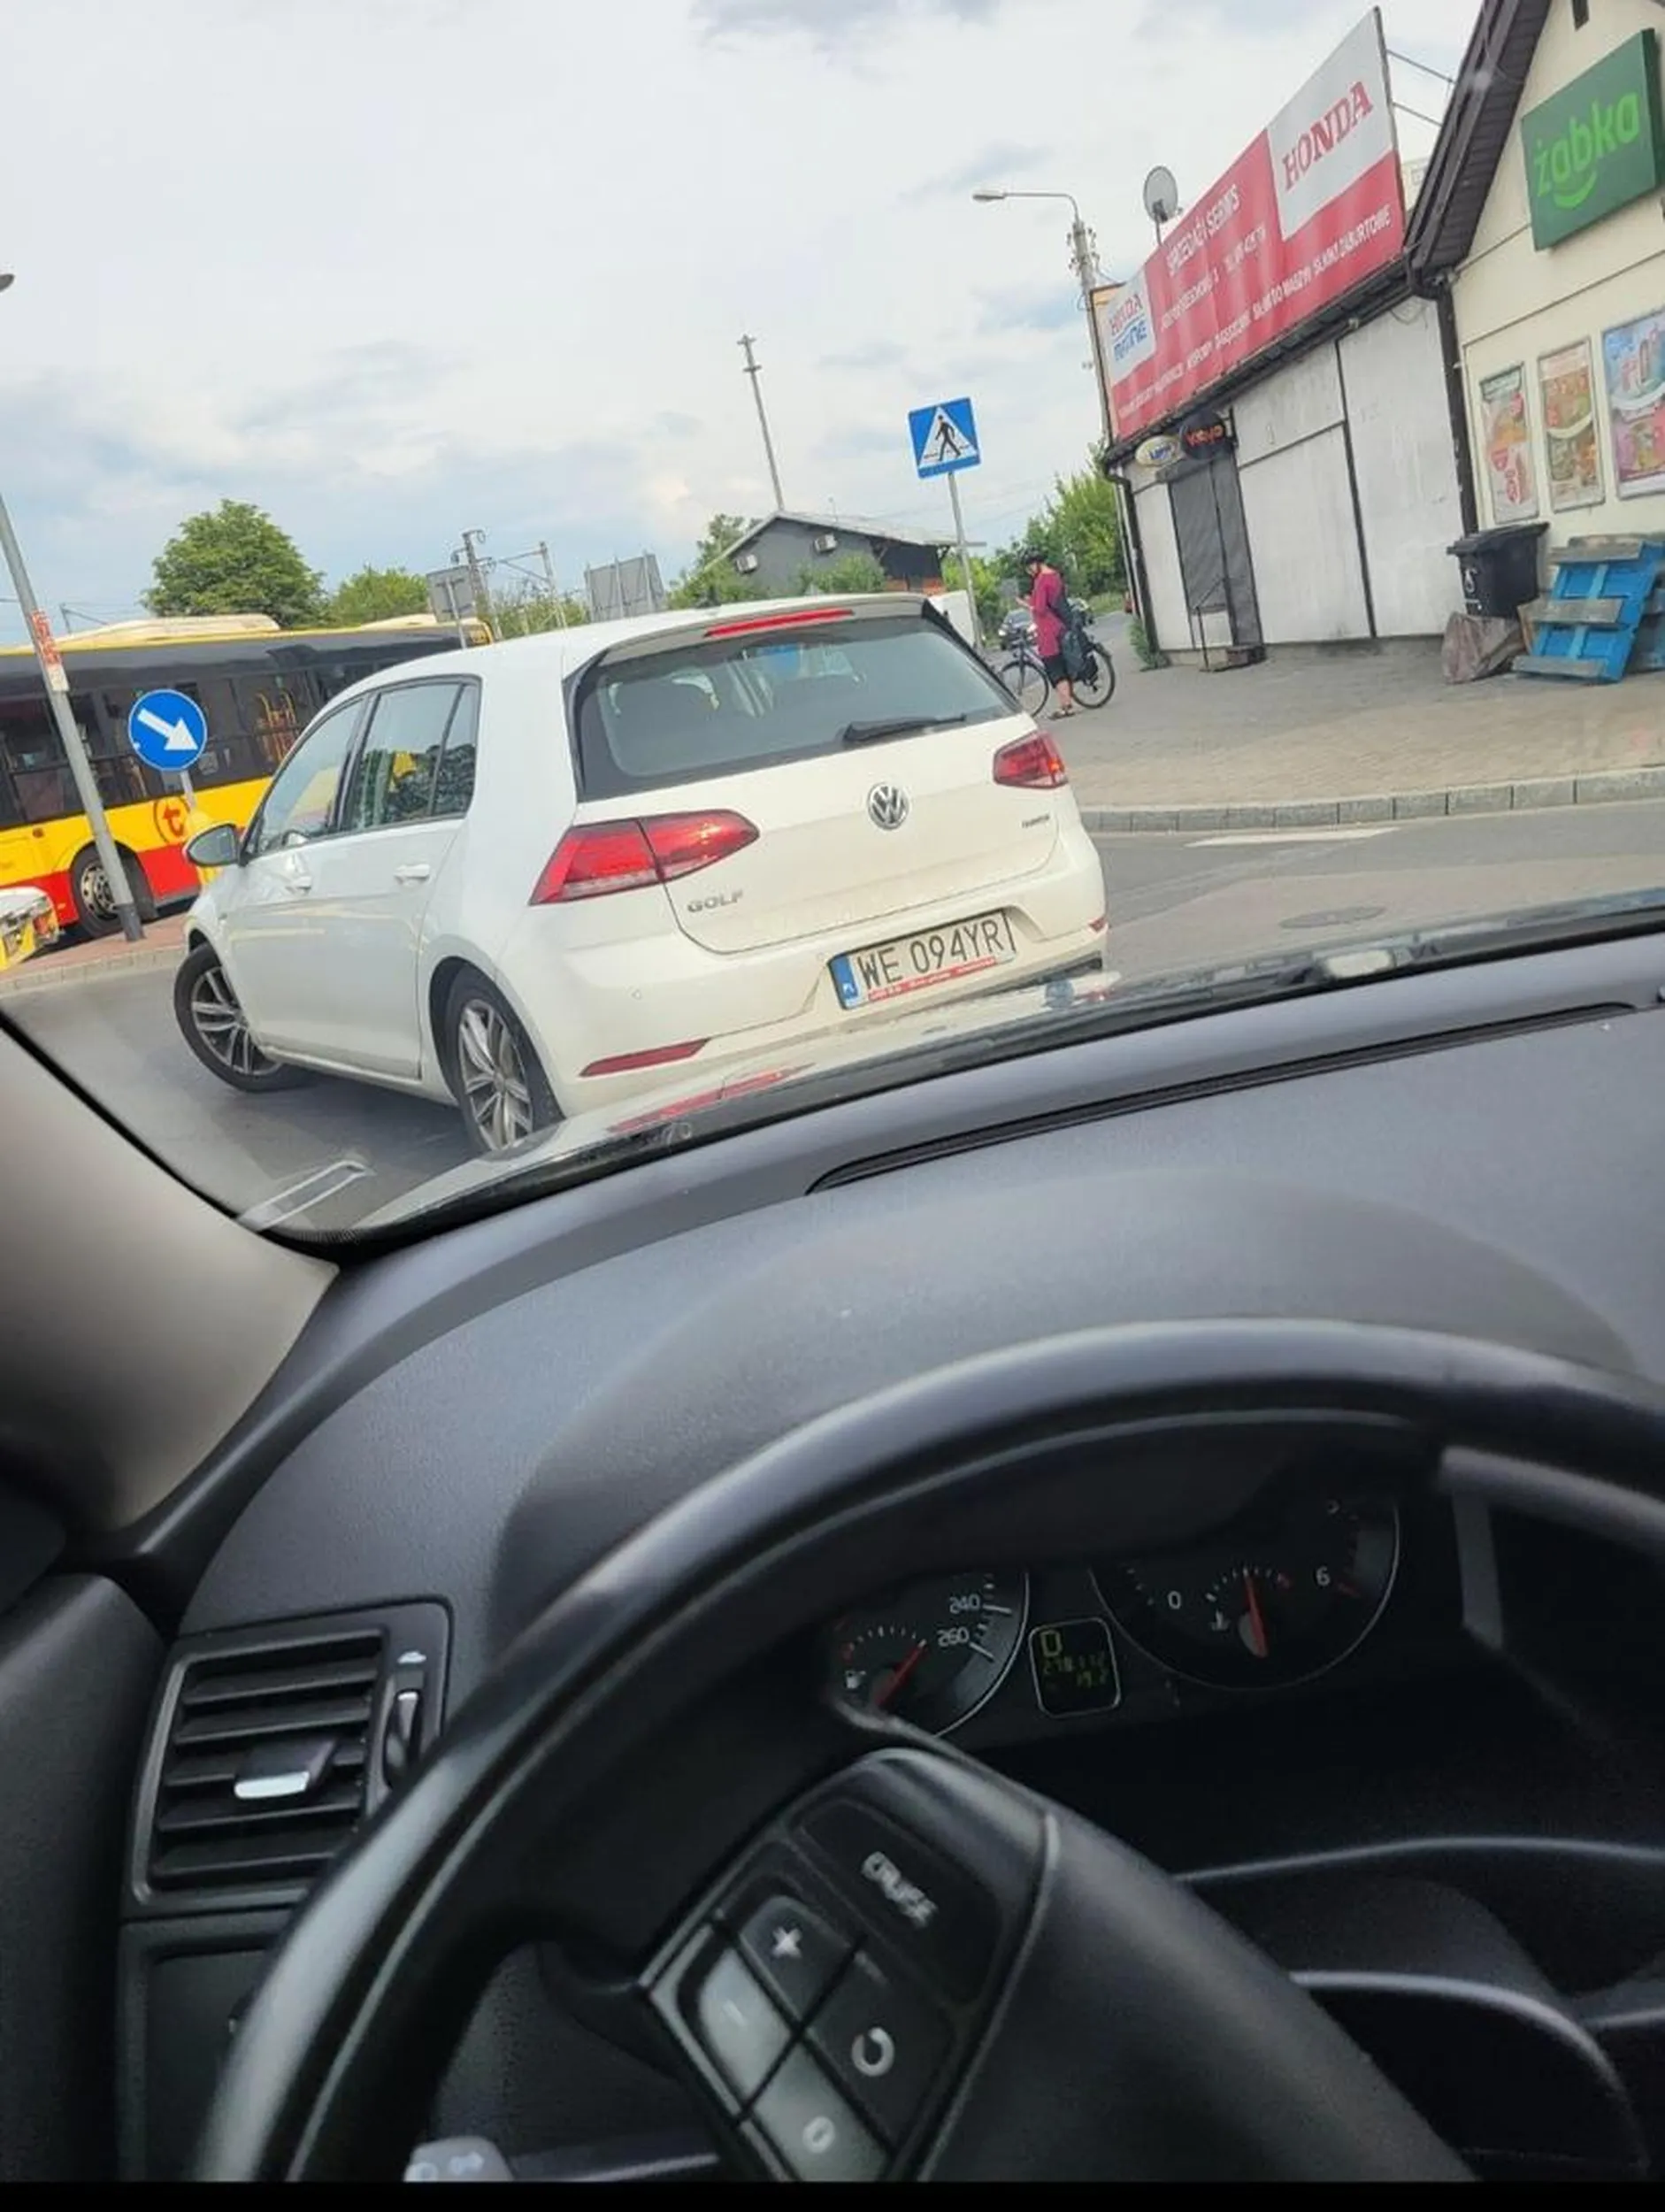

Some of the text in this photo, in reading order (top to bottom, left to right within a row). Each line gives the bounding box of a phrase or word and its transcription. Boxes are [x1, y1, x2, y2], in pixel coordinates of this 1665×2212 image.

[1282, 81, 1373, 191] HONDA
[687, 888, 744, 913] GOLF
[856, 947, 903, 989] WE
[909, 918, 1004, 973] 094YR
[949, 1594, 980, 1614] 240
[938, 1626, 970, 1647] 260
